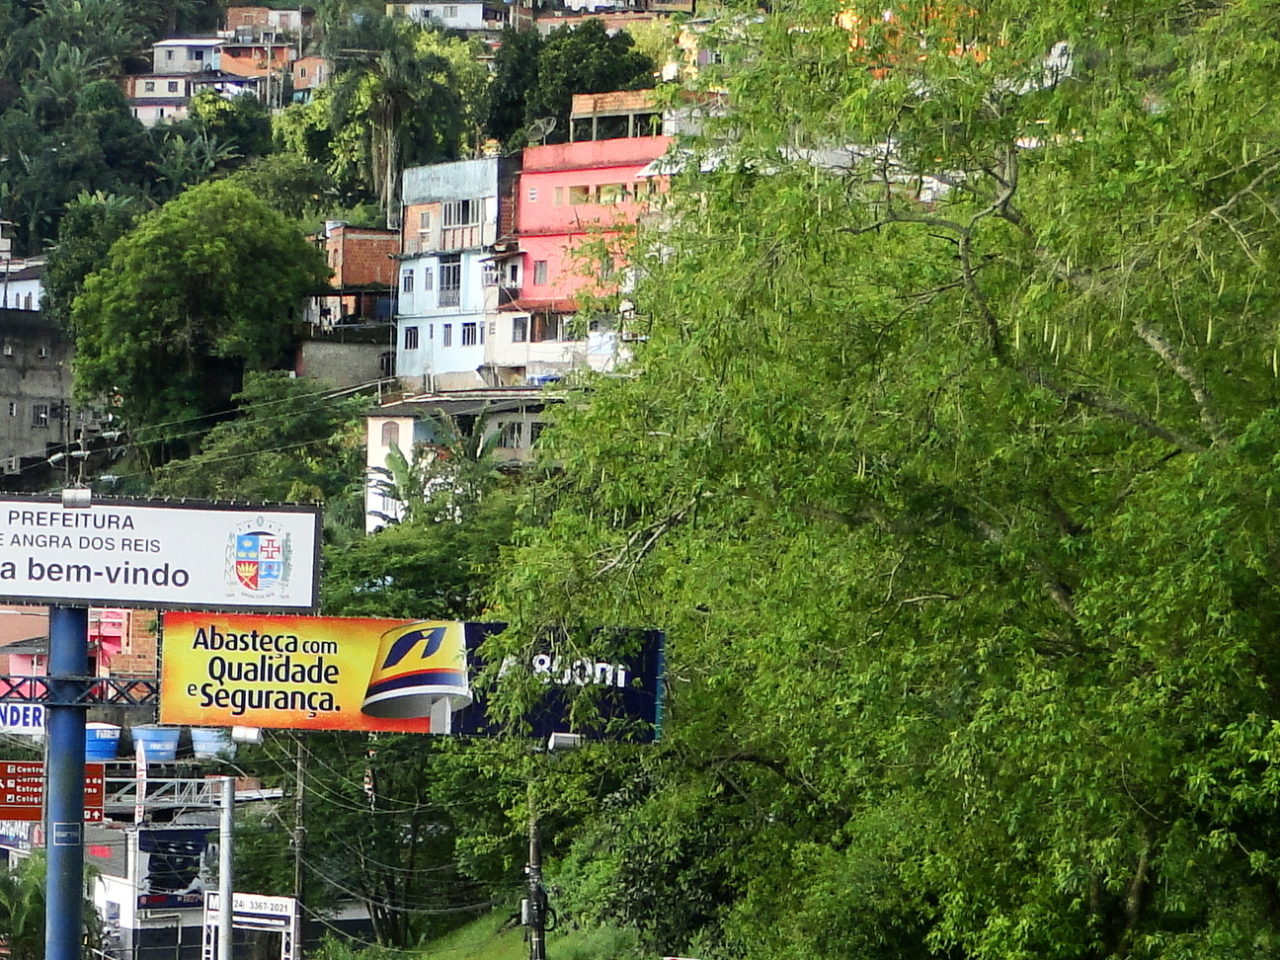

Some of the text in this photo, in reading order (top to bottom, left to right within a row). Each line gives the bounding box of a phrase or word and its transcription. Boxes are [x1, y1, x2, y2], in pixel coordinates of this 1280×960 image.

[8, 510, 135, 530] PREFEITURA
[10, 533, 72, 550] ANGRA
[79, 537, 116, 551] DOS
[121, 538, 161, 553] REIS
[28, 557, 190, 588] bem-vindo
[193, 625, 338, 659] Abasteça com
[208, 655, 340, 686] Qualidade
[187, 683, 342, 718] e Segurança.
